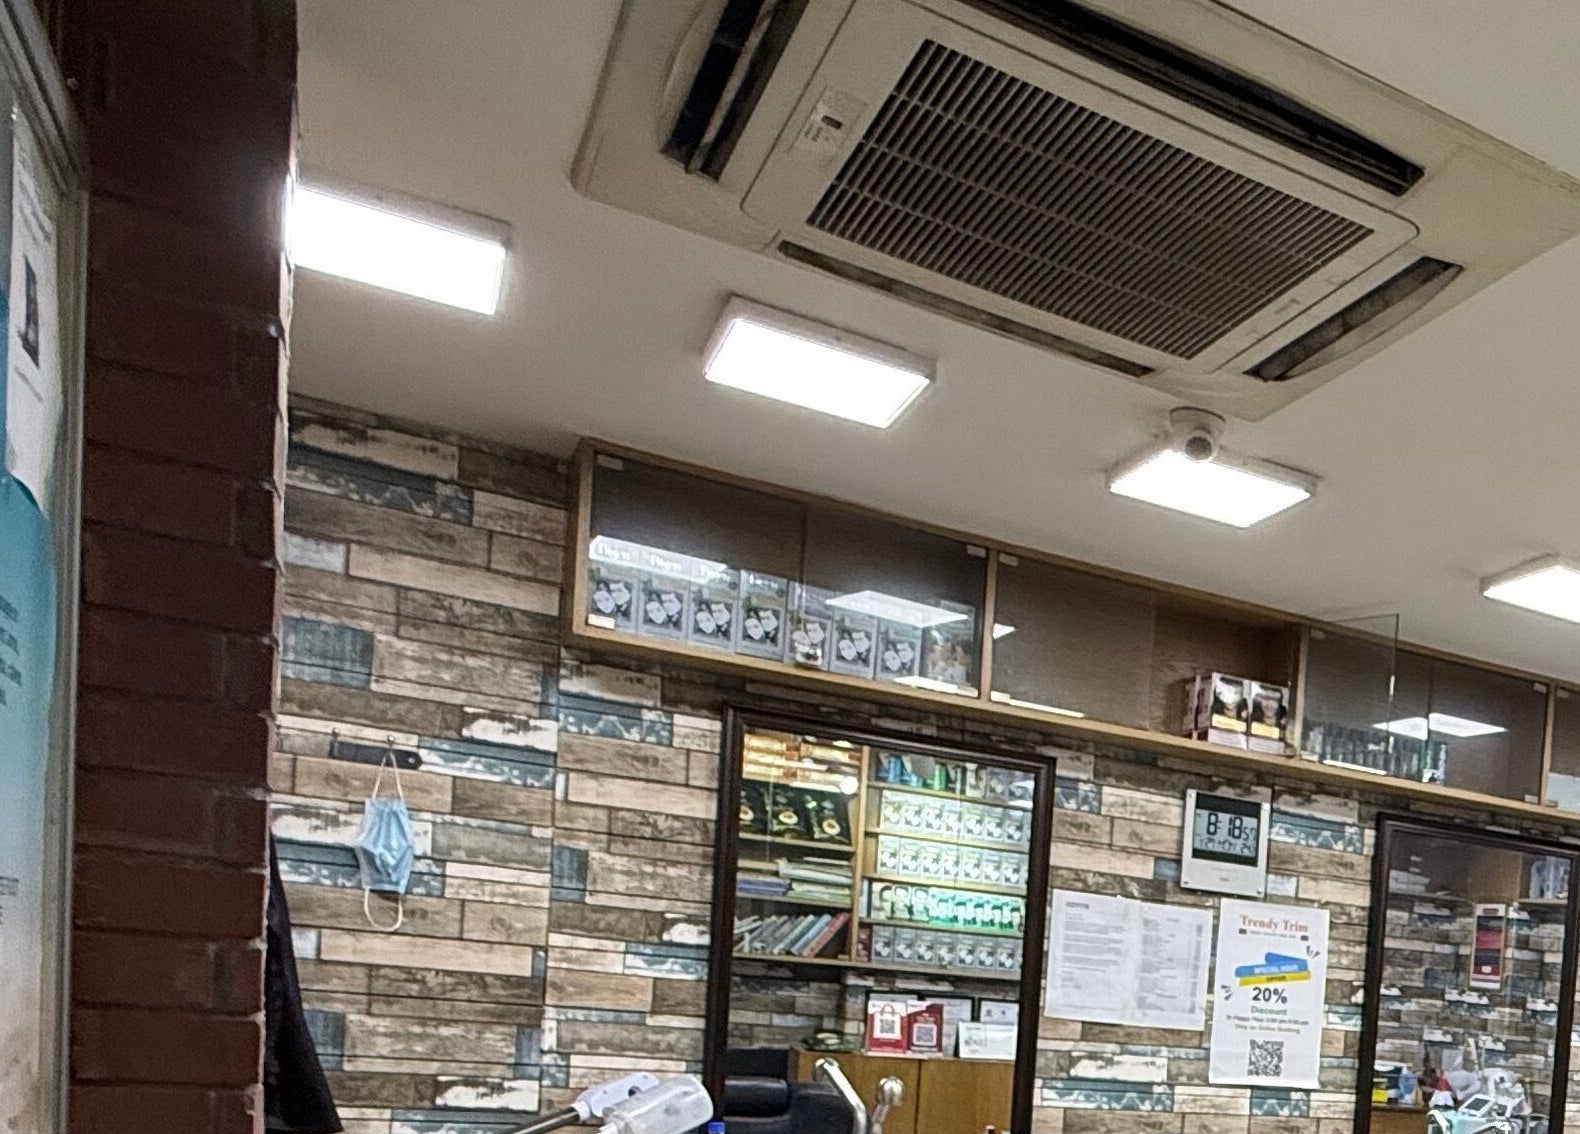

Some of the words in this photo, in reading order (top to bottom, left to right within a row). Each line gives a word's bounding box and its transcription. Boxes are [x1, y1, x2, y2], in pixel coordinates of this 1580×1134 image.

[1206, 812, 1243, 839] 8:18
[1241, 914, 1278, 931] Trendy
[1283, 919, 1308, 932] Trim
[1251, 986, 1288, 1004] 20%
[1251, 1006, 1287, 1016] Discount
